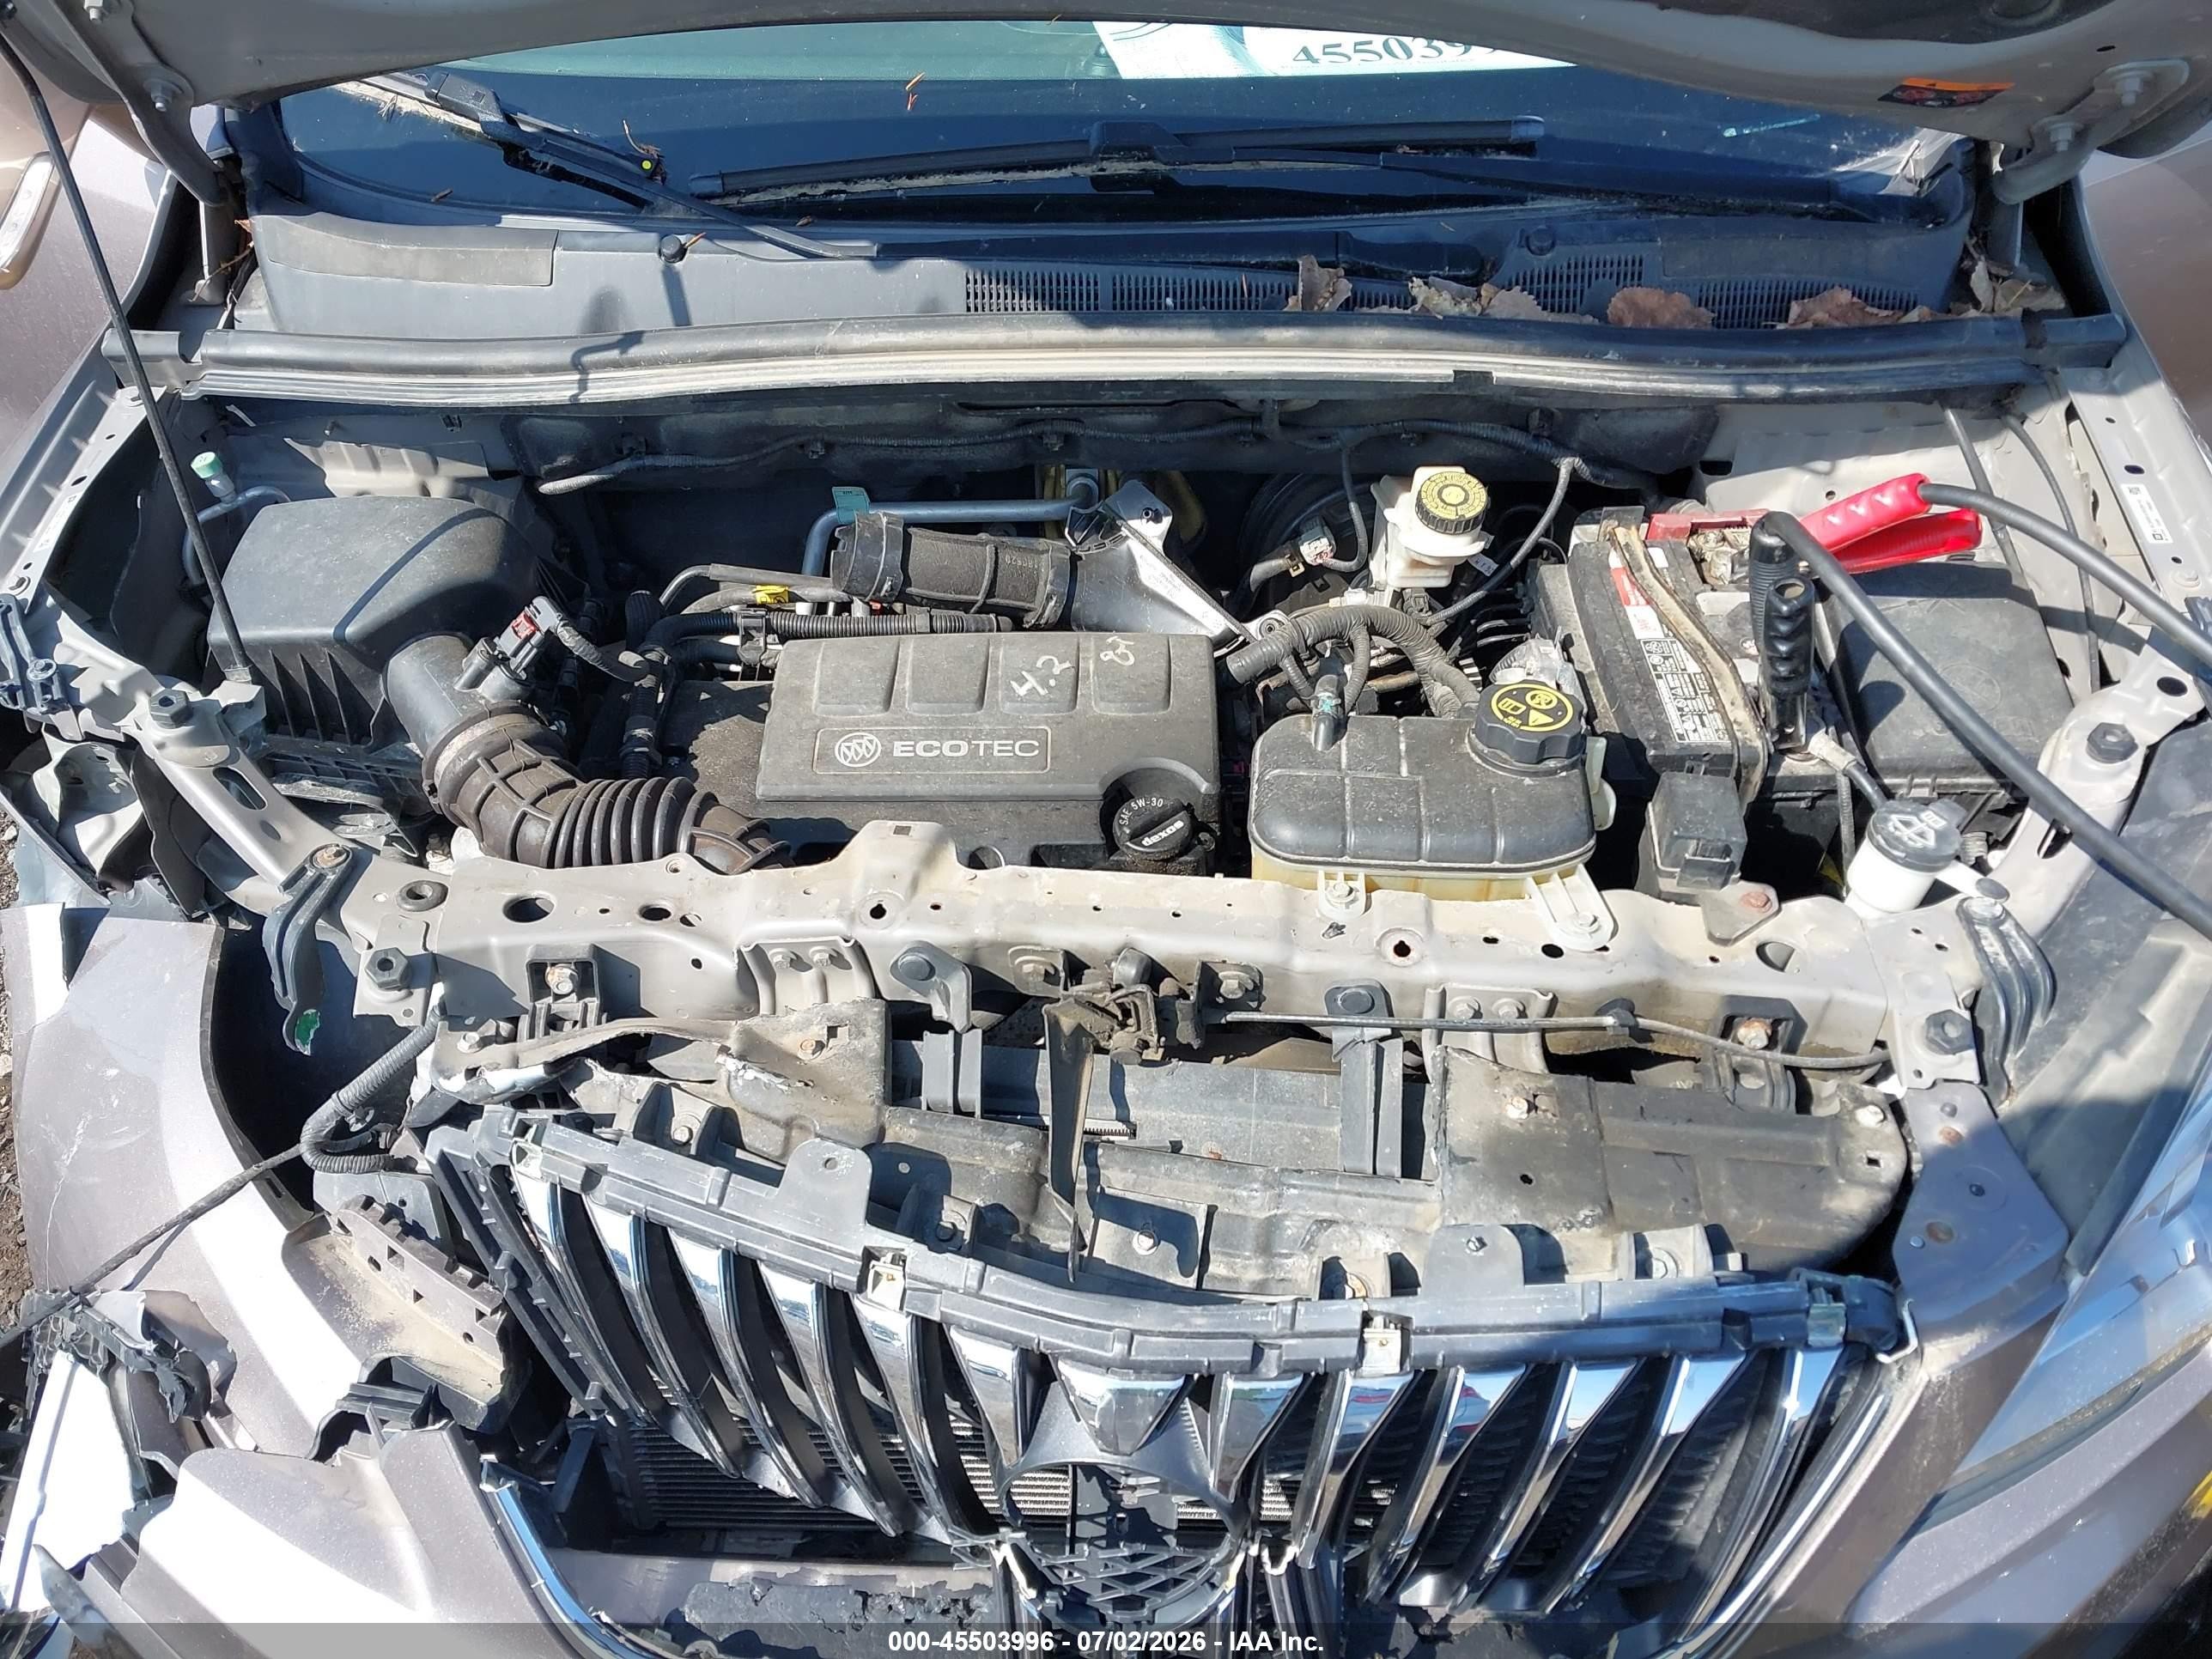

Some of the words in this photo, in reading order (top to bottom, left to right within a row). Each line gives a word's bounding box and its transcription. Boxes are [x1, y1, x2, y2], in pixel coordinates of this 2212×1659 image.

[893, 739, 1040, 757] ECOTEC
[1119, 808, 1133, 825] SAE
[1131, 797, 1164, 811] 5W-30
[1141, 820, 1184, 846] dexos
